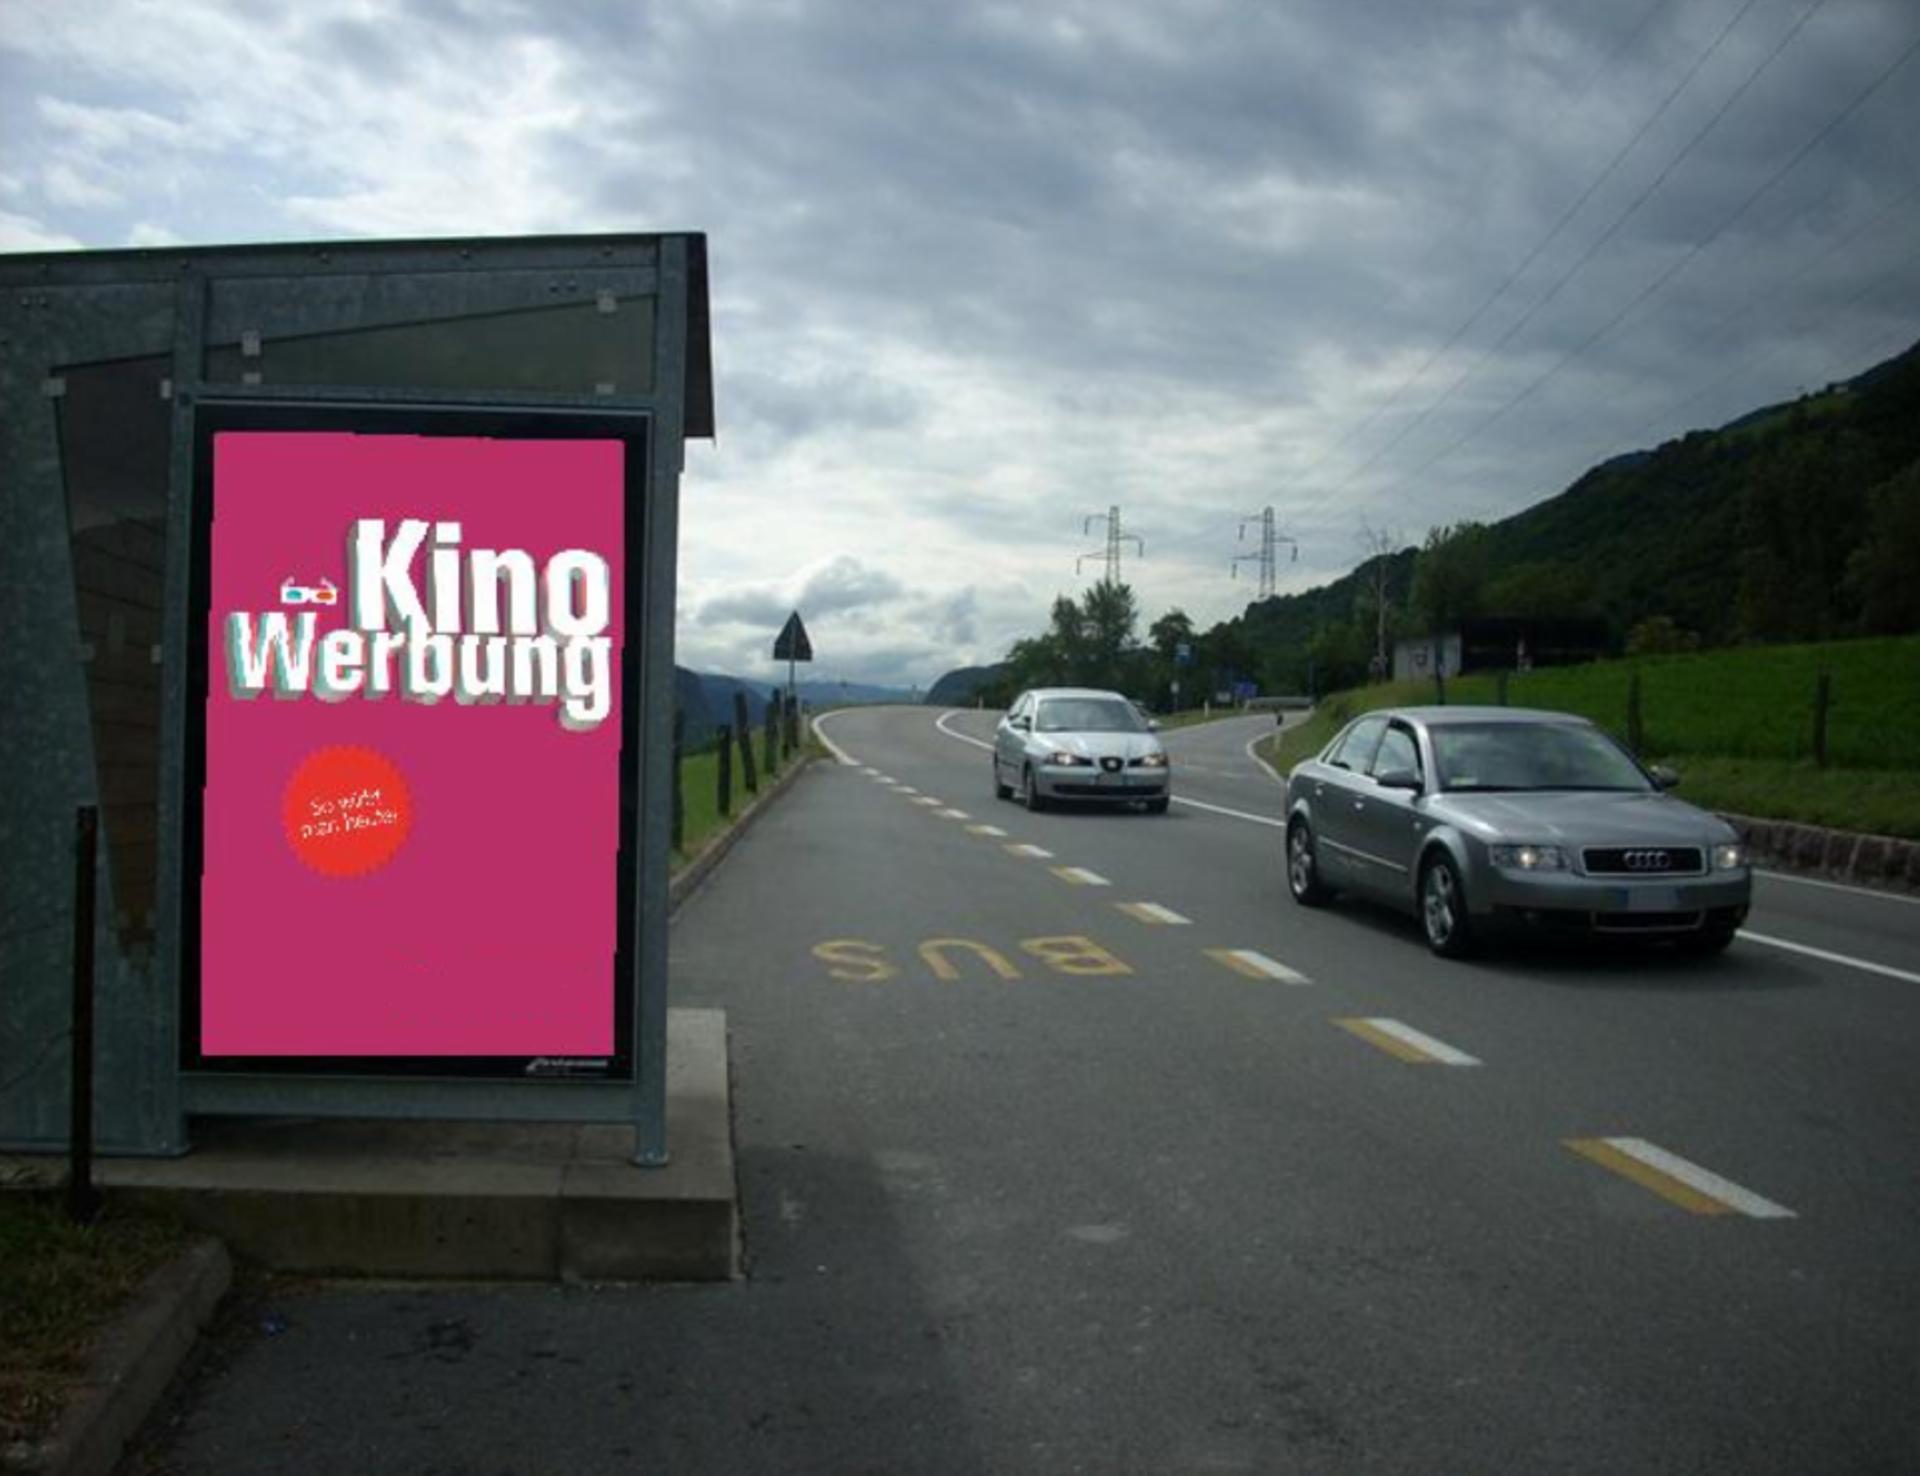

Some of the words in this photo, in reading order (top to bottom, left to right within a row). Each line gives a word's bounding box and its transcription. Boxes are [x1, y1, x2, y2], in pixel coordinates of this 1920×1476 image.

[347, 518, 610, 636] Kino
[228, 611, 612, 728] Werbung
[811, 935, 1134, 981] BUS
